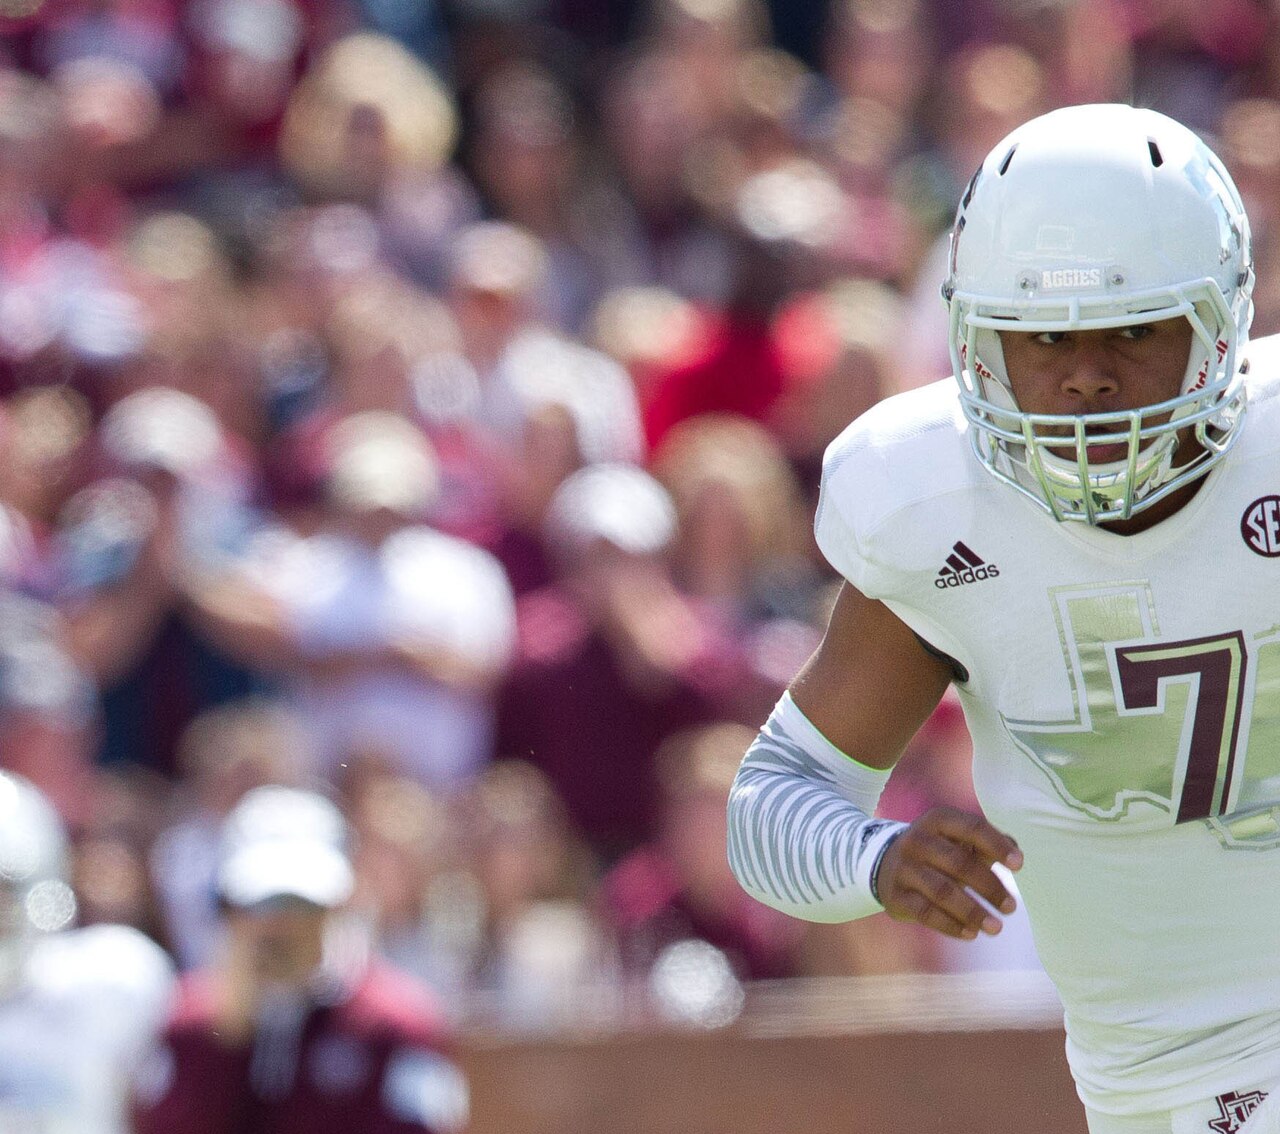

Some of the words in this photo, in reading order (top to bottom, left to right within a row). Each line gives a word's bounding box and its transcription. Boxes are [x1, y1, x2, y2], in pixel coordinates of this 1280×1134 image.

[1041, 268, 1101, 289] AGGIES
[934, 561, 1000, 590] adidas
[1114, 629, 1249, 825] 7
